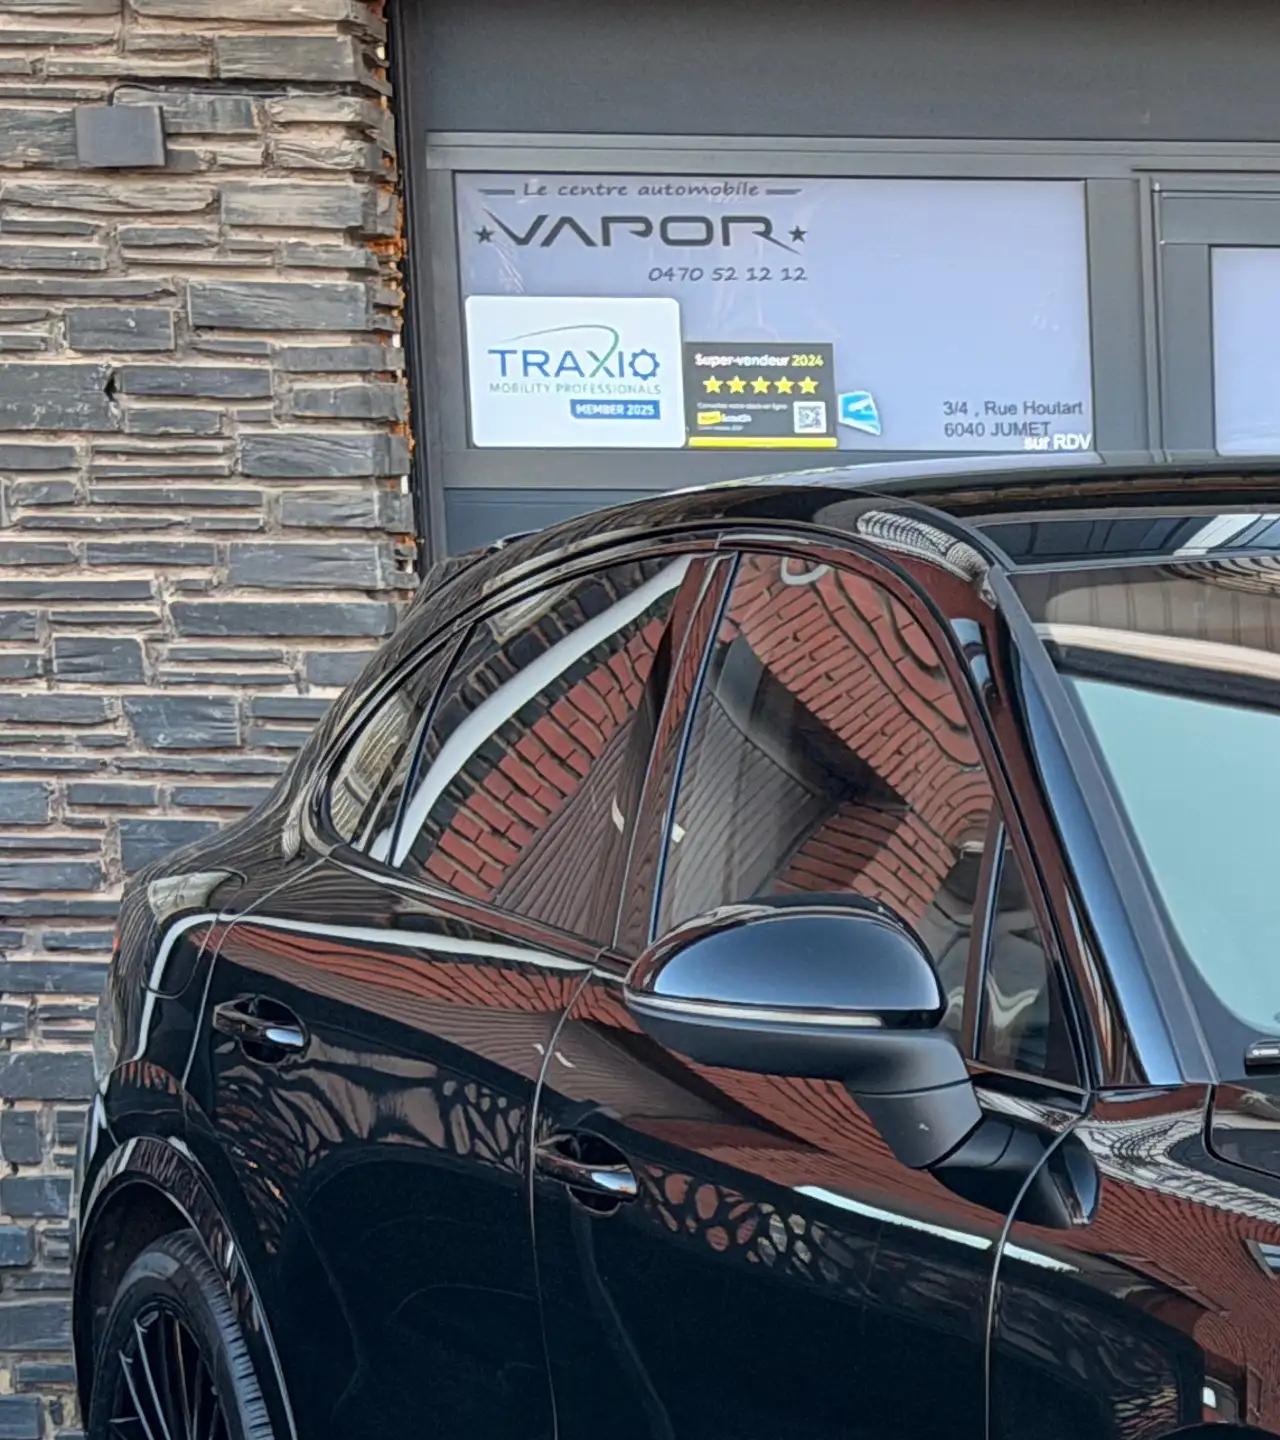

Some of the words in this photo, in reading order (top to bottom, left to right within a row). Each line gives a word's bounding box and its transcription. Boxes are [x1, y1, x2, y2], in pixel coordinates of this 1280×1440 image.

[523, 181, 547, 196] Le
[558, 184, 628, 196] centre
[638, 181, 759, 196] automobile
[483, 207, 801, 255] VAPOR
[648, 267, 703, 282] 0470
[711, 267, 738, 282] 52
[747, 267, 772, 282] 12
[781, 267, 807, 282] 12
[487, 346, 661, 381] TRAXIO
[791, 354, 824, 367] 2024
[489, 382, 550, 394] MOBILITY
[556, 383, 662, 395] PROFESSIONALS
[575, 404, 625, 415] MEMBER
[627, 405, 654, 415] 2025
[943, 400, 968, 416] 3/4
[984, 400, 1018, 416] Rue
[944, 422, 985, 437] 6040
[990, 421, 1052, 437] JUMET
[1053, 433, 1093, 450] RDV
